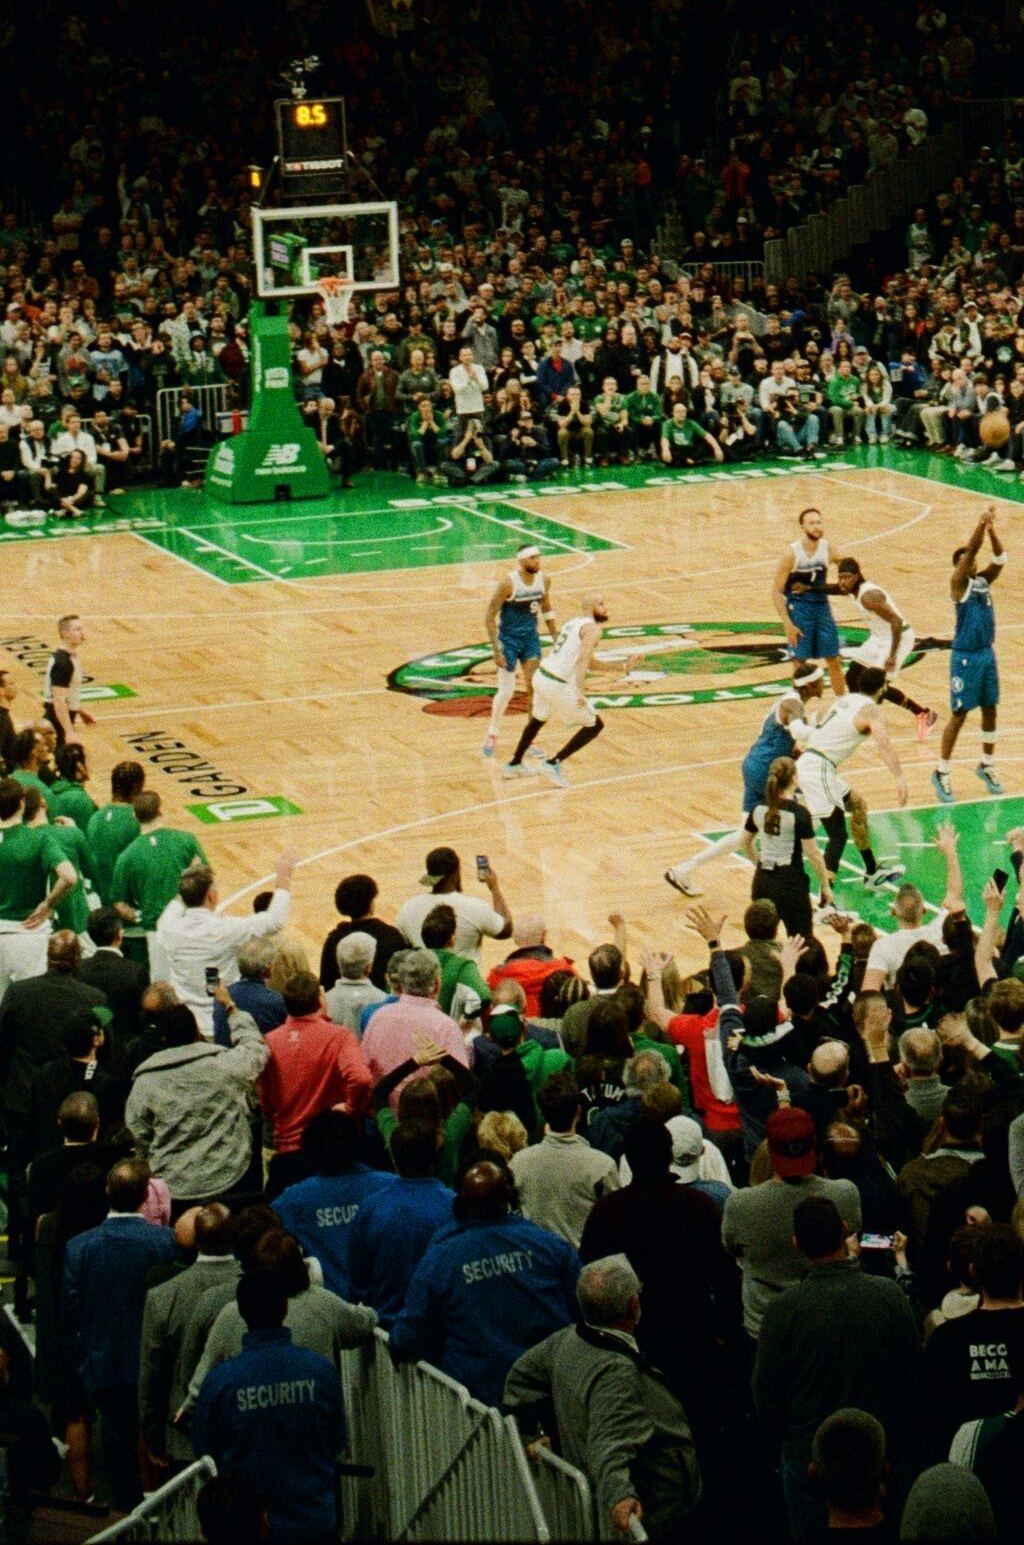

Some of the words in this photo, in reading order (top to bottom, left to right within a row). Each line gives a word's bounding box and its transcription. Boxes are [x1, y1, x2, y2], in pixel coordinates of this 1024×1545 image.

[295, 104, 326, 126] 8.5
[388, 482, 629, 508] BOSTON
[121, 730, 249, 797] GARDEN
[207, 797, 281, 822] TD
[581, 1084, 626, 1103] TAUM
[316, 1205, 359, 1228] SECUR
[462, 1250, 534, 1285] SECURITY
[971, 1359, 981, 1372] A
[237, 1379, 316, 1412] SECURITY
